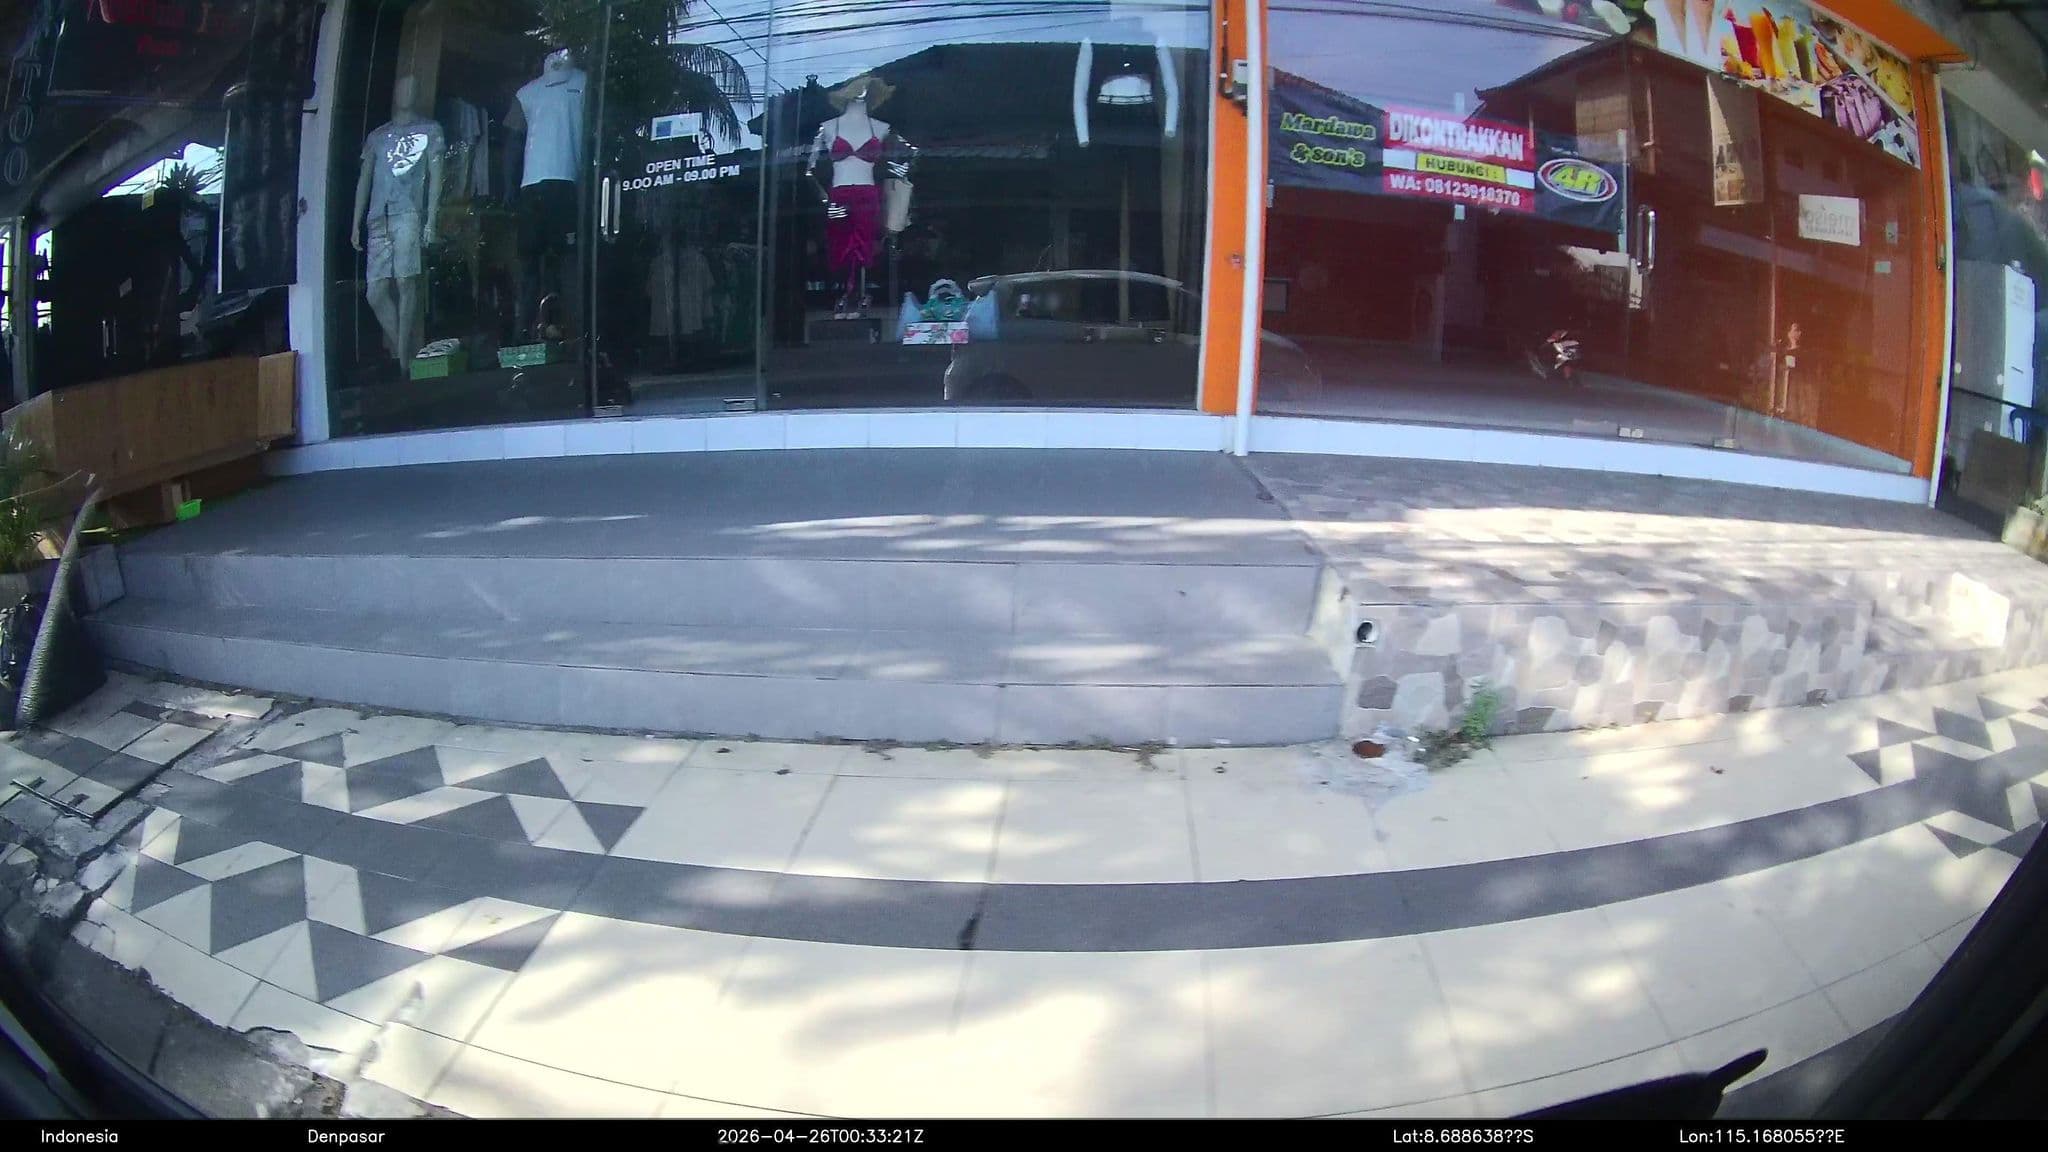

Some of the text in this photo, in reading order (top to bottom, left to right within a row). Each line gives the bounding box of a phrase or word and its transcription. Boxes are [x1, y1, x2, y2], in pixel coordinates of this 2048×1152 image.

[1389, 111, 1524, 161] DIKONTRAKKAN
[646, 154, 716, 174] OPEN TIME
[653, 173, 674, 187] AM
[720, 164, 740, 178] PM
[1389, 173, 1421, 191] WA:
